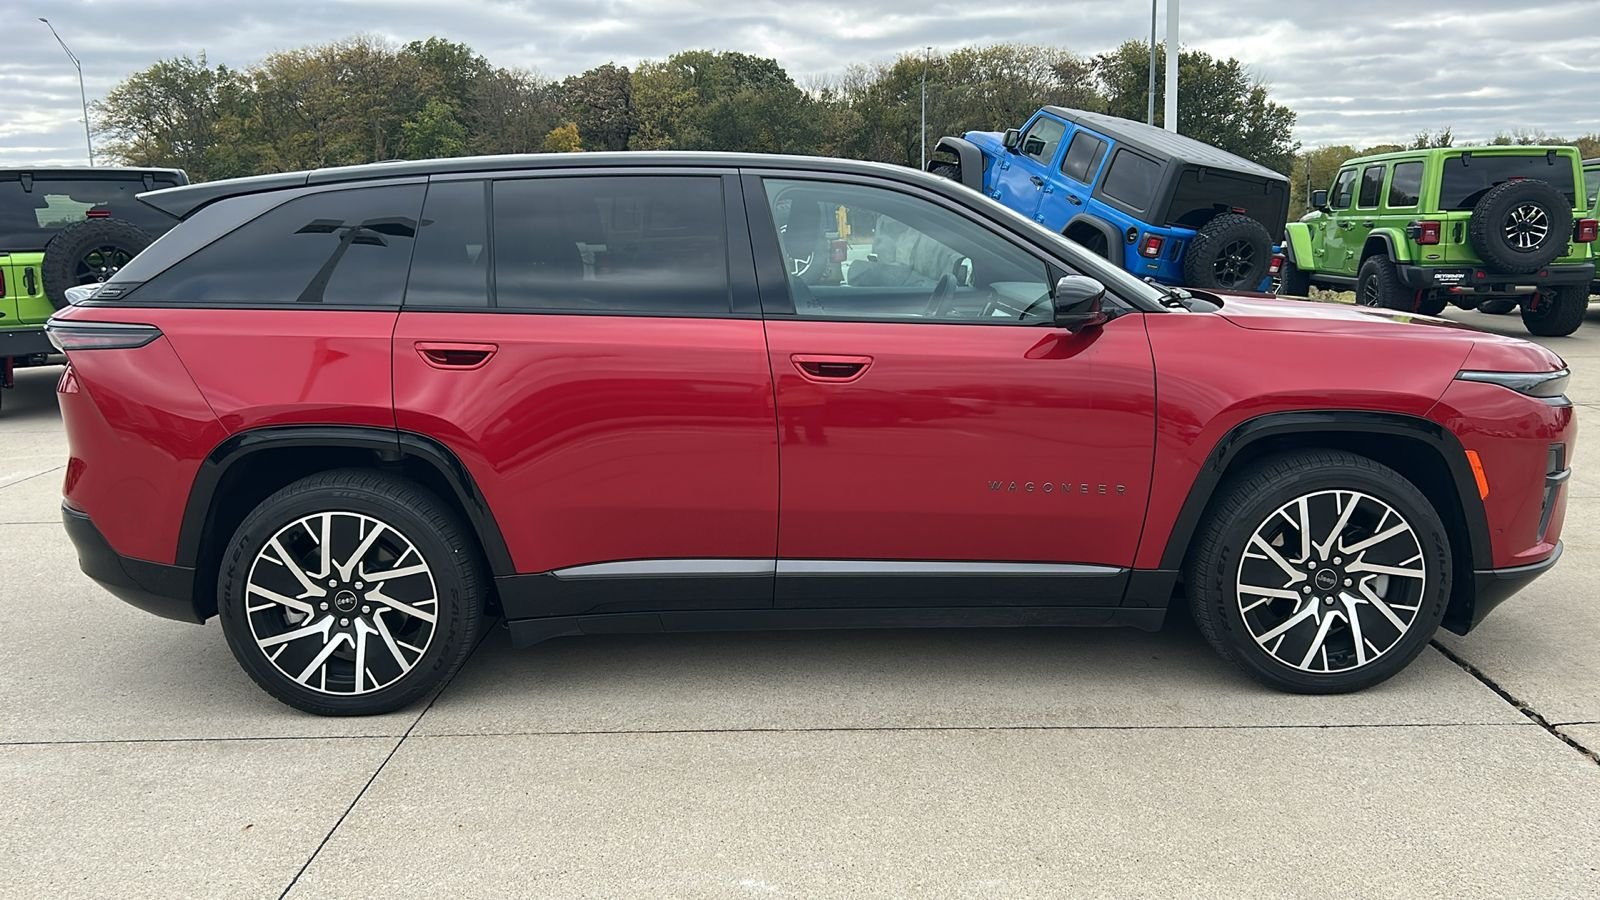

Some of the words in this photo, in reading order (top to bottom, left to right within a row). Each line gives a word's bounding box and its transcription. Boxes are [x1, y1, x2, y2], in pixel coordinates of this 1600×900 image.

[987, 479, 1127, 495] WAGONEER
[223, 534, 249, 620] FALKEN
[1215, 546, 1233, 631] FALKEN
[1318, 575, 1335, 585] Jeep
[1431, 531, 1446, 617] FALKEN
